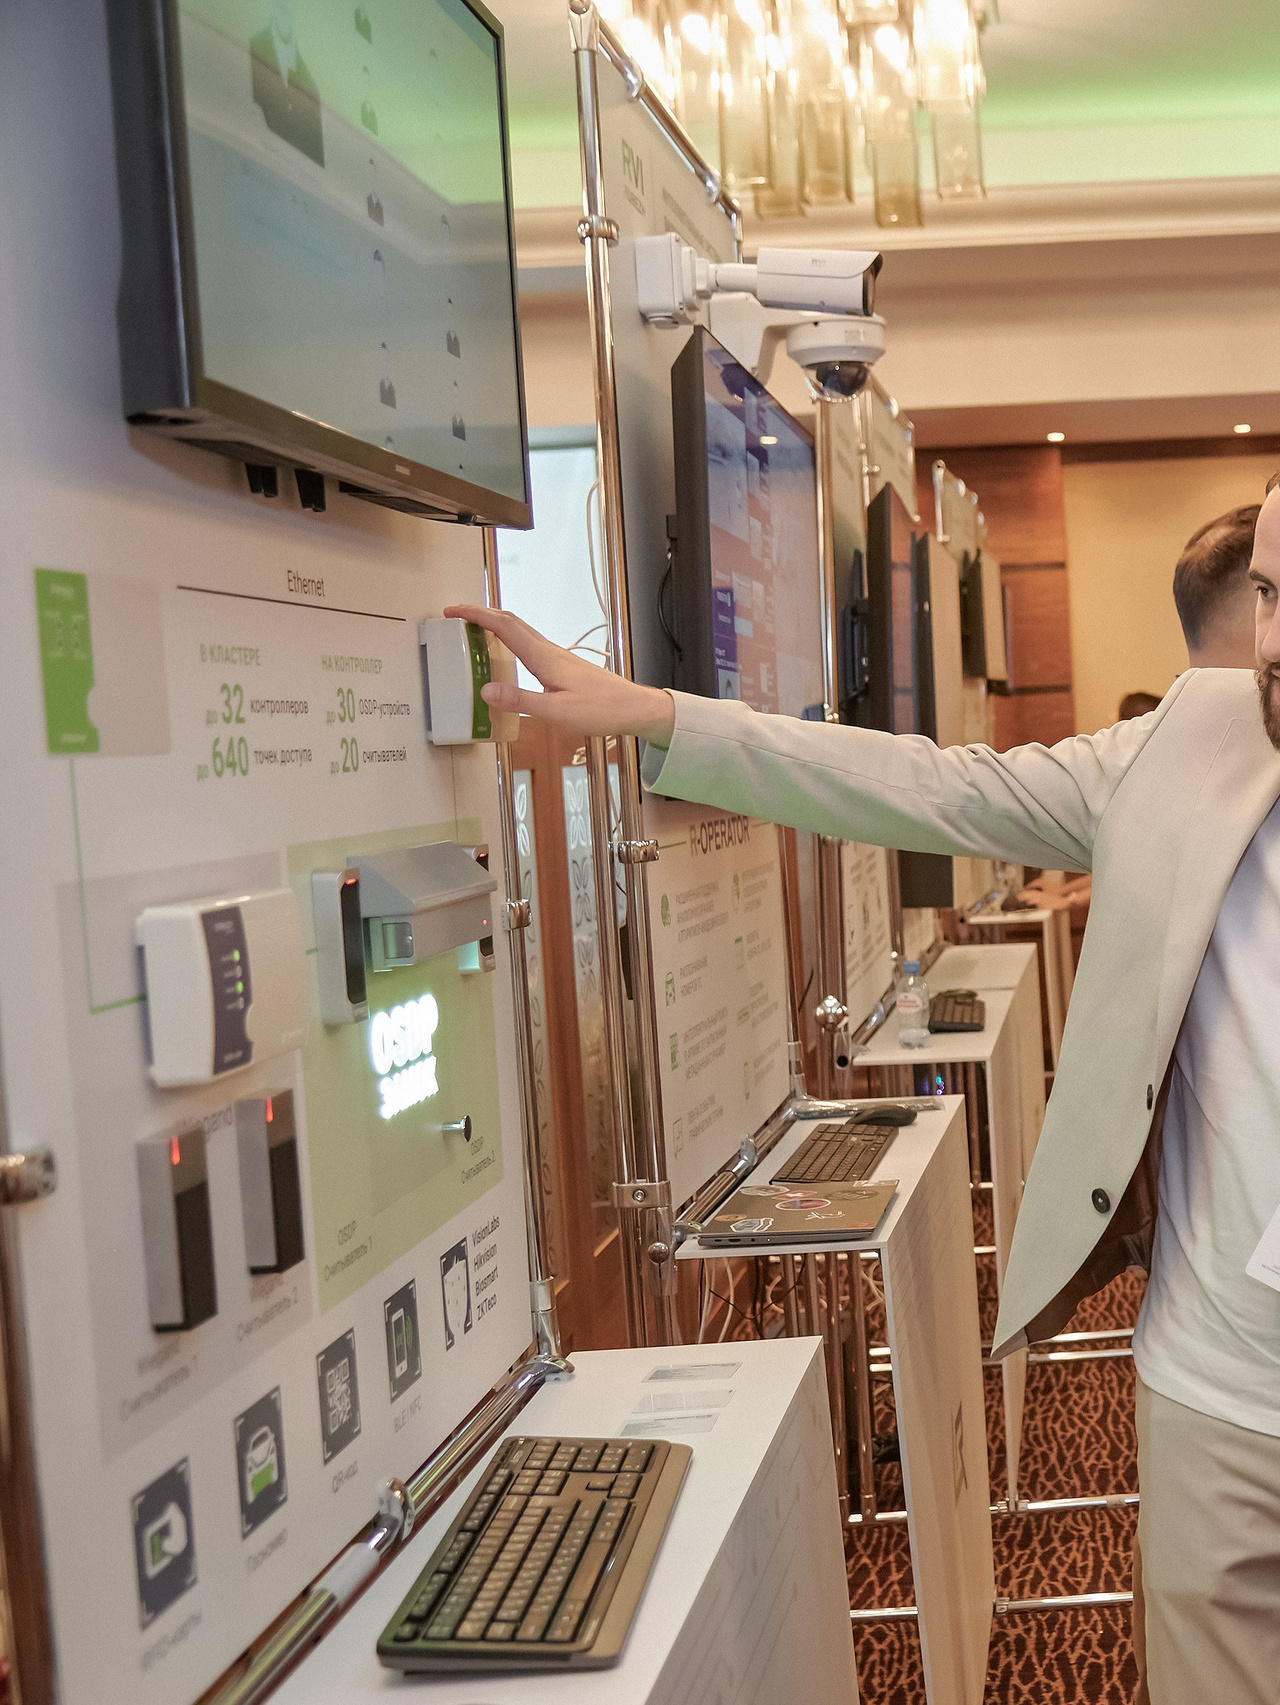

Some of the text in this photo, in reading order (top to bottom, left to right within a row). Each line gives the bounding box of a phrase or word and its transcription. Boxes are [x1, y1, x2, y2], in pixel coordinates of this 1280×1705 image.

[287, 570, 325, 597] Ethernet
[201, 644, 261, 666] В КЛАСТЕРЕ
[321, 654, 383, 674] НА КОНТРОЛЛЕР
[220, 683, 246, 724] 32
[250, 700, 309, 718] контроллеров
[327, 711, 335, 725] до
[337, 687, 356, 723] 30
[212, 736, 249, 778] 640
[254, 750, 278, 765] точек
[280, 748, 313, 767] доступа
[330, 737, 407, 776] до 20 считывателей
[690, 815, 750, 857] R-OPERATOR
[471, 1136, 484, 1155] OSDP
[338, 1220, 357, 1246] OSDP
[472, 1215, 500, 1247] VisionLabs
[324, 1244, 368, 1282] Считыватель
[474, 1243, 498, 1272] Hikvision
[475, 1265, 499, 1297] Biosmart
[477, 1293, 497, 1321] ZKTeco
